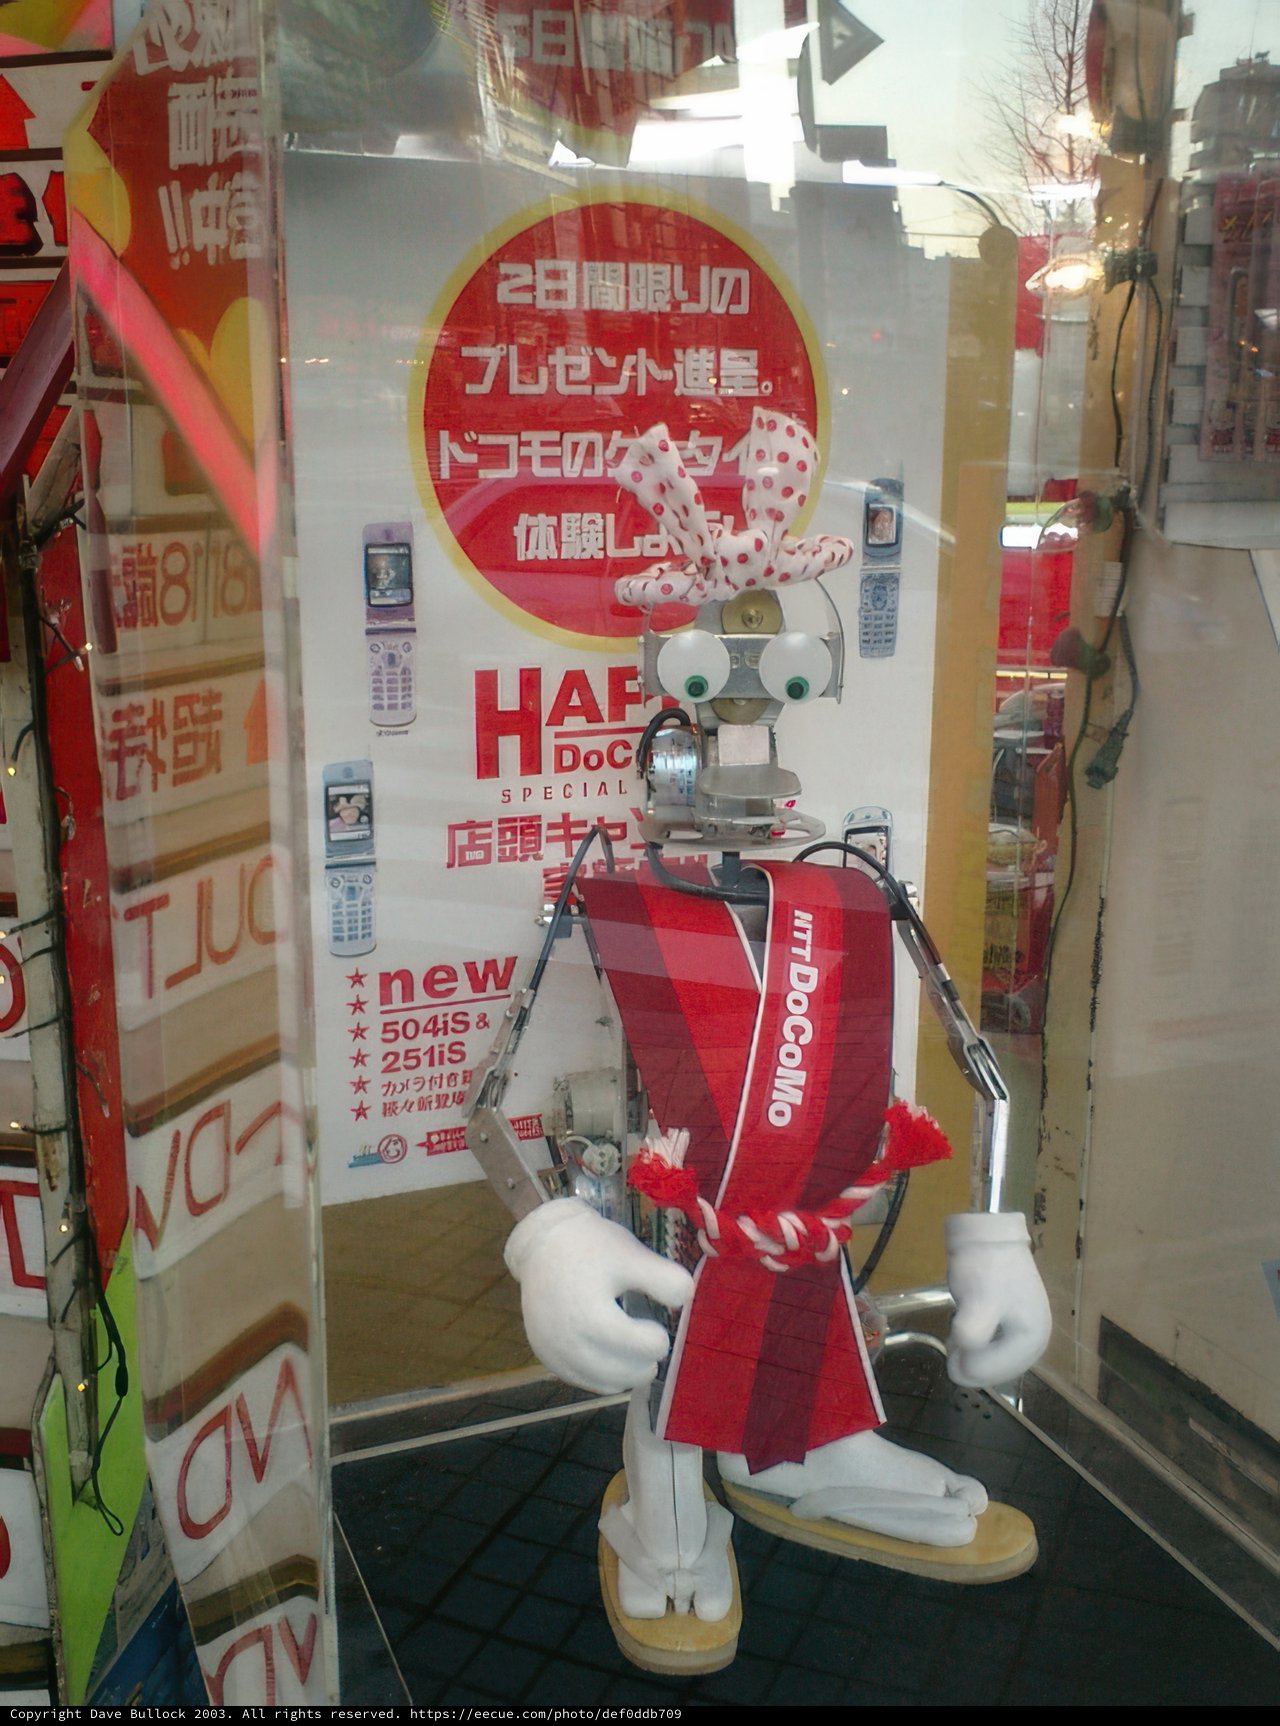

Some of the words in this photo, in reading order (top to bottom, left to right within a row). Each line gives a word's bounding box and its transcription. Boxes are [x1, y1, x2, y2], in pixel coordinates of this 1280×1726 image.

[496, 259, 749, 314] 2日間限りの
[460, 343, 773, 397] プレゼント進呈。
[501, 780, 628, 804] SPECIAL
[791, 909, 814, 962] NTT
[379, 956, 518, 1006] new
[380, 1011, 471, 1043] 504iS
[475, 1012, 491, 1030] &
[767, 961, 819, 1127] DoCoMo
[380, 1041, 466, 1074] 251iS
